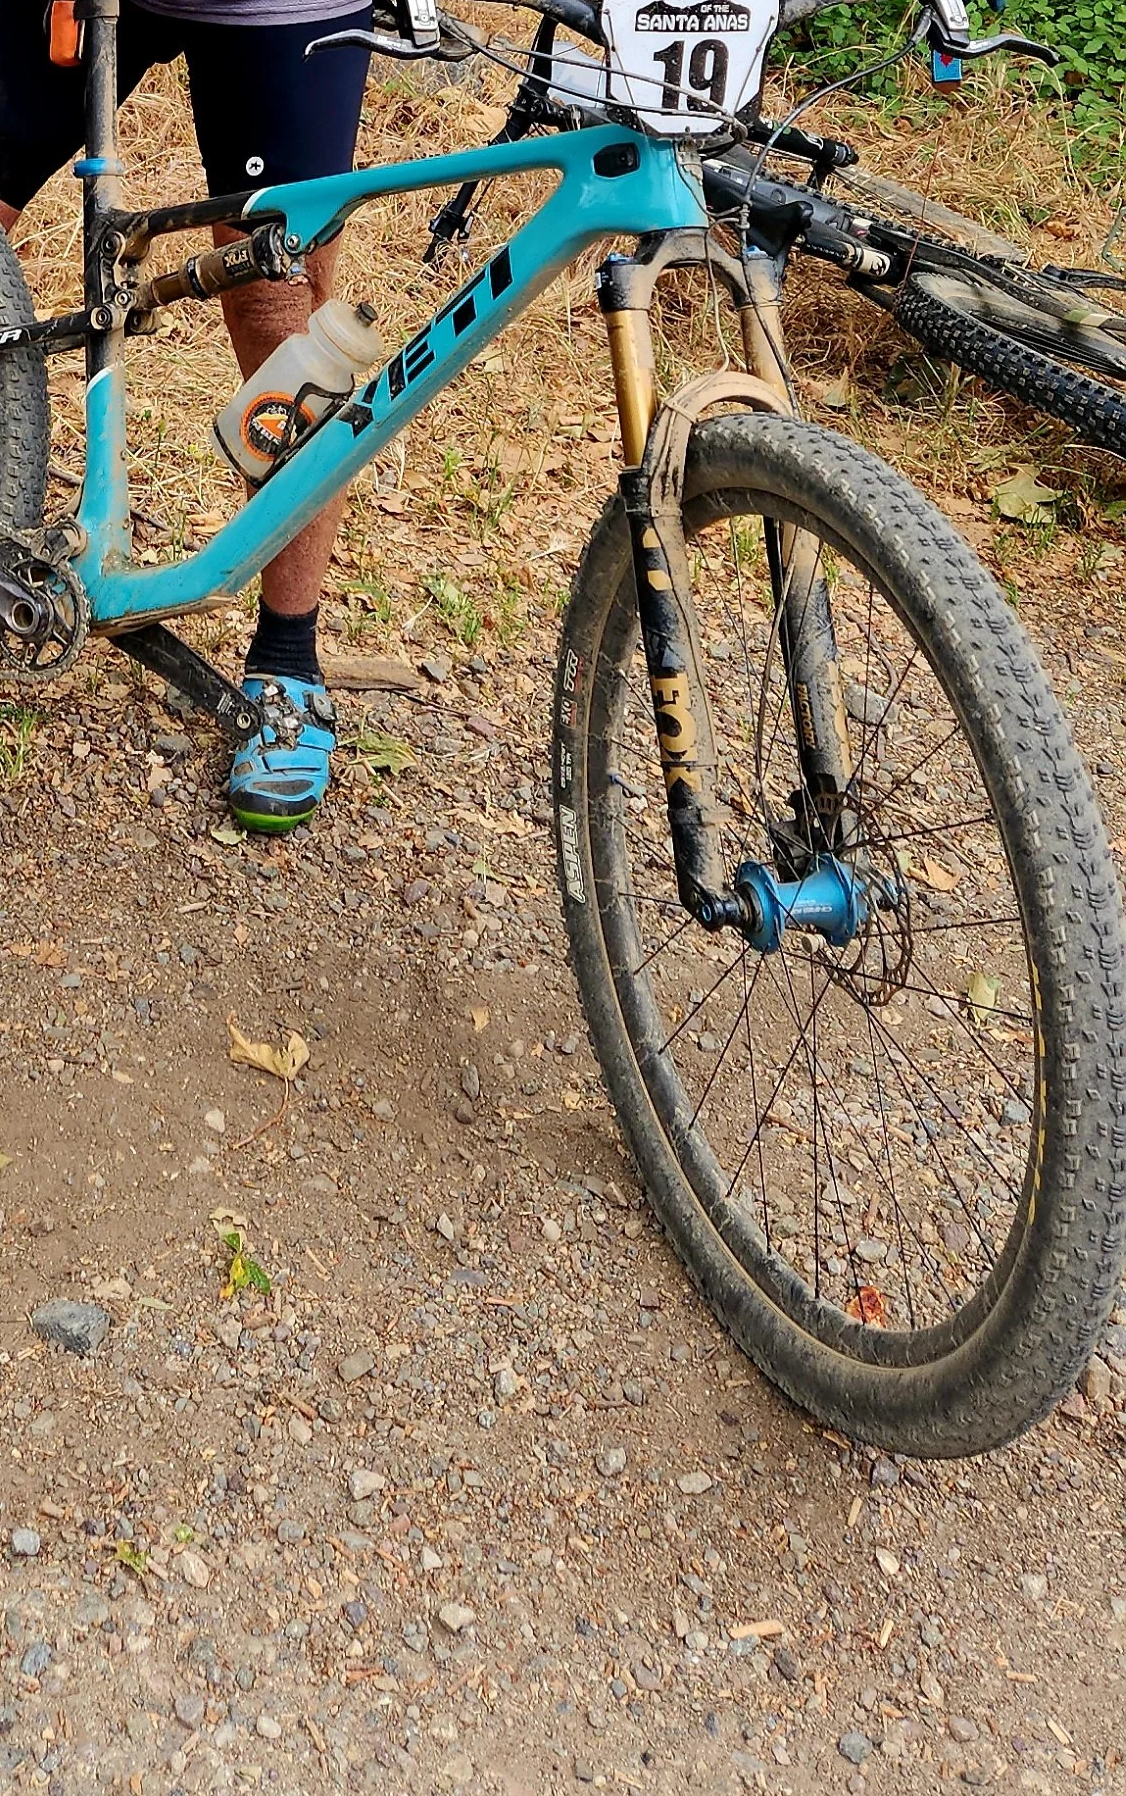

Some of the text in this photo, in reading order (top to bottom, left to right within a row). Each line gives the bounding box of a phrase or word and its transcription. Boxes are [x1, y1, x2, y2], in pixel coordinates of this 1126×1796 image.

[637, 14, 749, 31] SANTA ANAS
[700, 4, 730, 13] OF THE
[653, 38, 729, 112] 19
[335, 244, 514, 439] YETI
[796, 683, 816, 749] FACTORY
[559, 804, 586, 903] ASPEN
